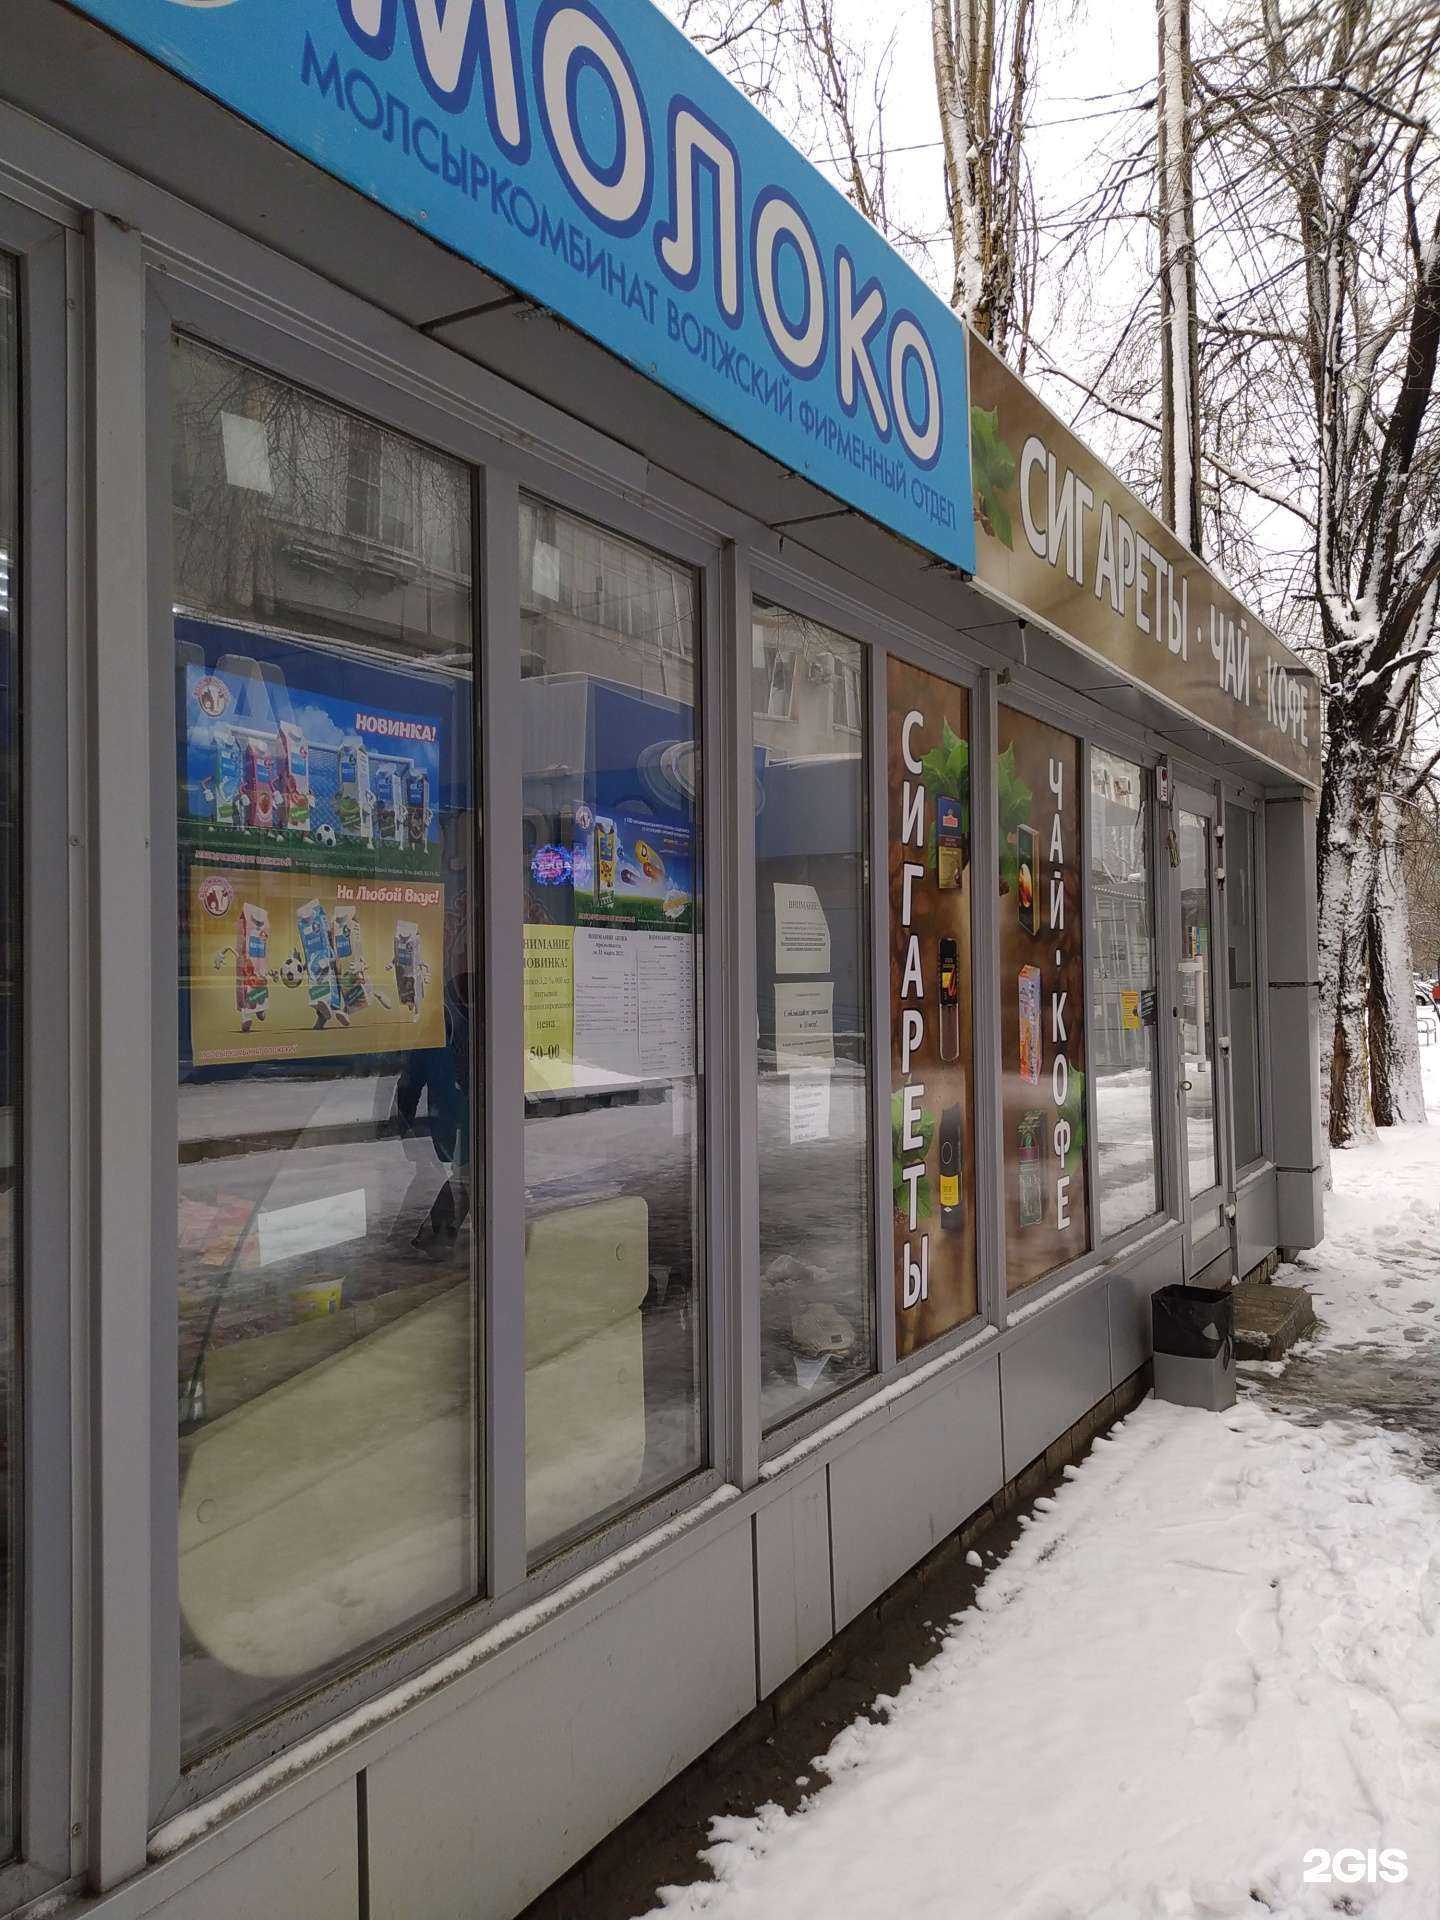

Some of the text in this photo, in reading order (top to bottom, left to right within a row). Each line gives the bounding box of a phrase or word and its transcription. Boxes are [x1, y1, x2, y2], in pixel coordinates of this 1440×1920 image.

[301, 30, 957, 531] МОЛСЫРКОМБИНАТ ВОЛЖСКИЙ ФИРМЕННЫЙ ОТДЕЛ
[355, 713, 437, 742] НОВИНКА!
[1019, 435, 1308, 747] СИГАРЕТЫ ЧАЙ КОФЕ
[337, 884, 439, 906] На Любой Вкус!
[901, 709, 929, 1310] СИГАРЕТЫ
[1049, 758, 1071, 1231] ЧАЙ КОФЕ
